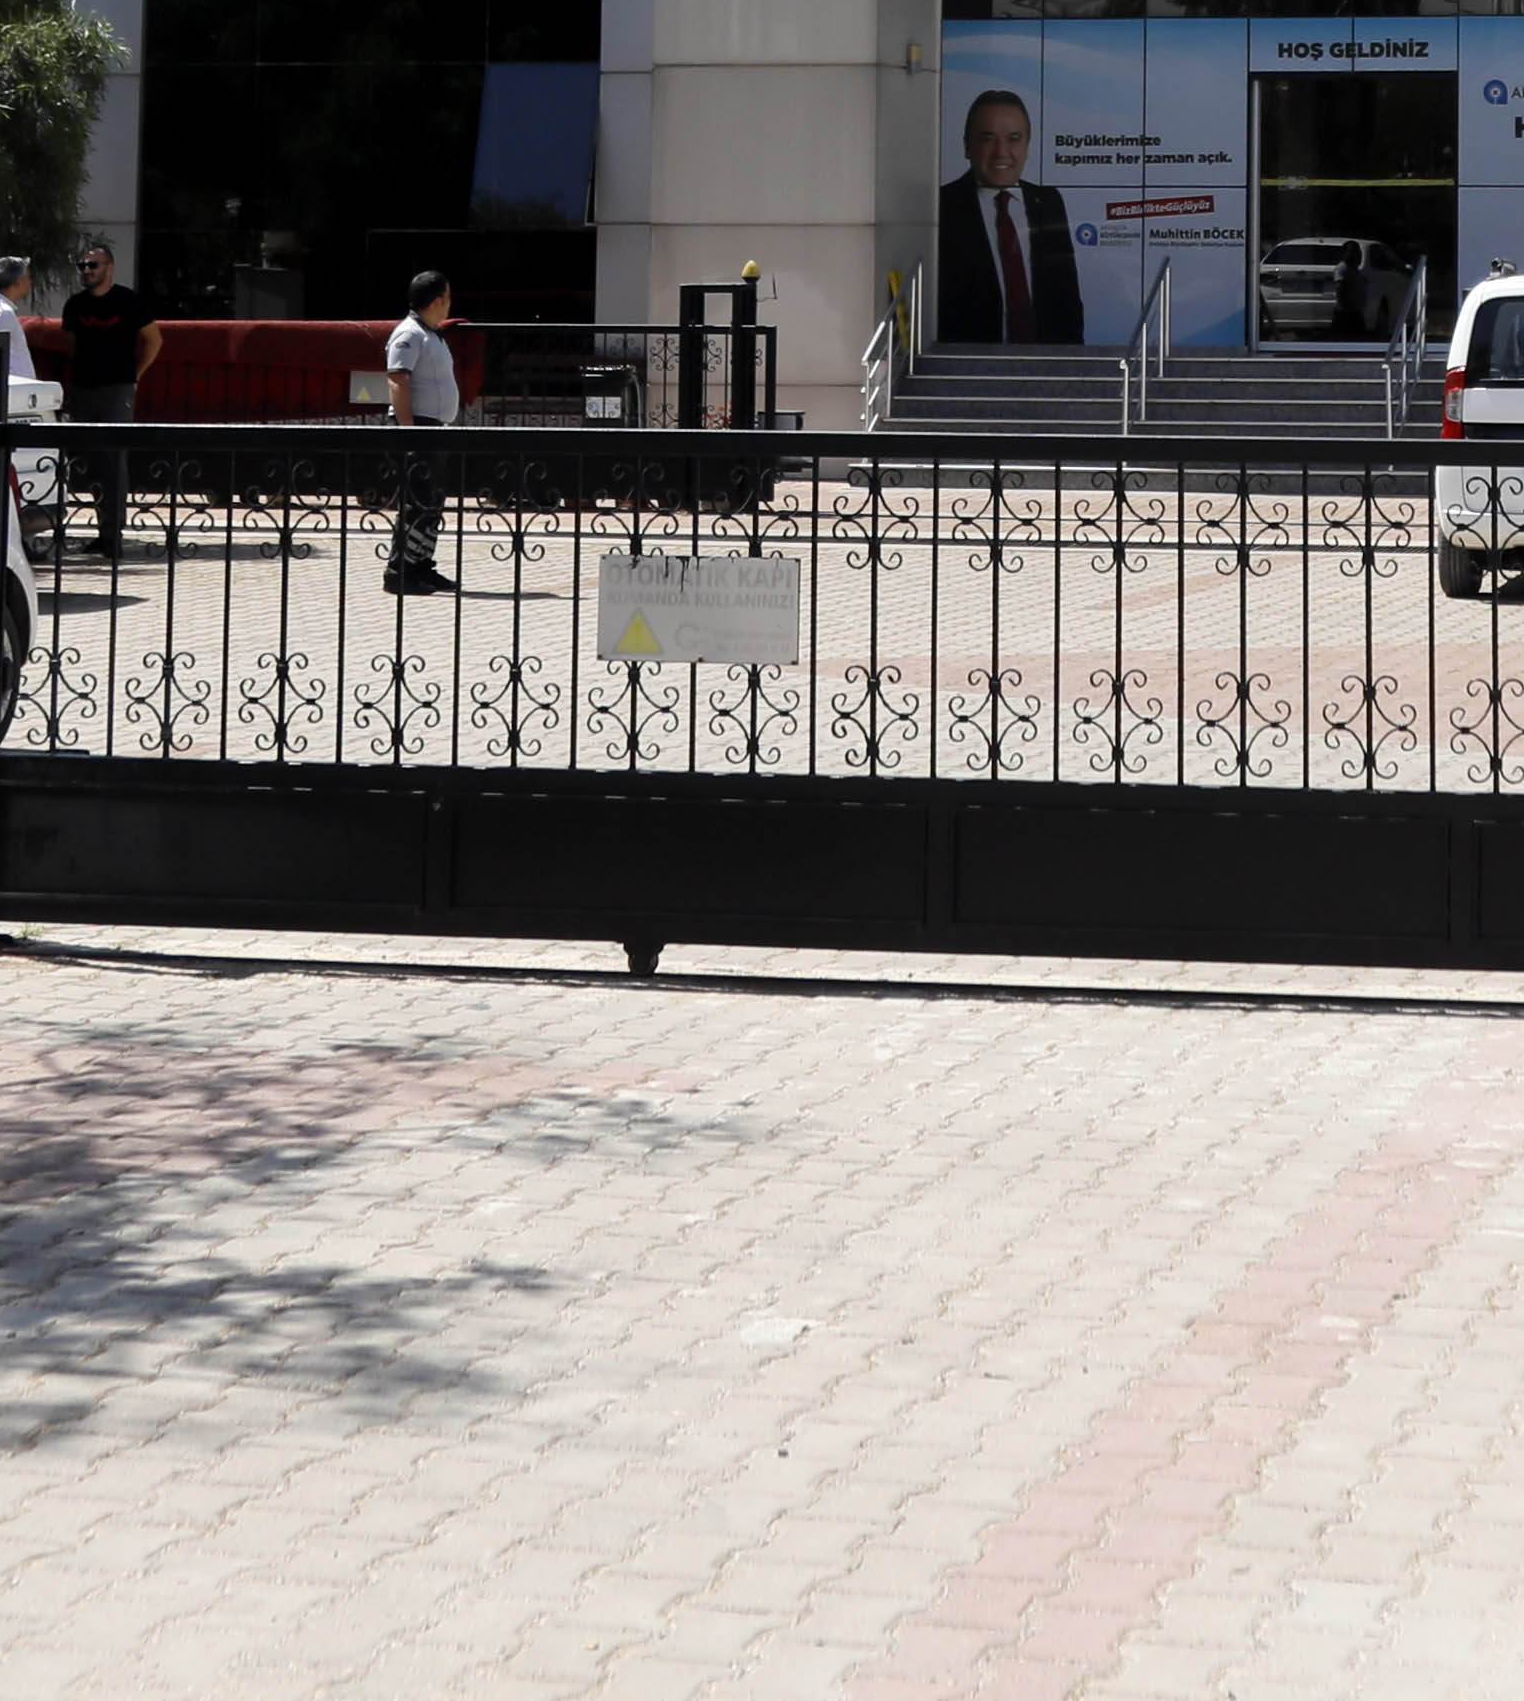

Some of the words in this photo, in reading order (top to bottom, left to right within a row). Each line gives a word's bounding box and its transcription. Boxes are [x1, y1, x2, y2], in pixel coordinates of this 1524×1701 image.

[1278, 42, 1323, 61] HOŞ
[1329, 38, 1429, 59] GELDİNİZ
[1055, 135, 1161, 149] Büyüklerimize
[1055, 153, 1113, 166] kapımız
[1116, 152, 1140, 164] her
[1144, 153, 1194, 164] zaman
[1198, 151, 1233, 165] açık.
[1149, 229, 1201, 240] Muhittin
[1203, 227, 1245, 240] BÖCEK
[738, 565, 793, 590] KAPI
